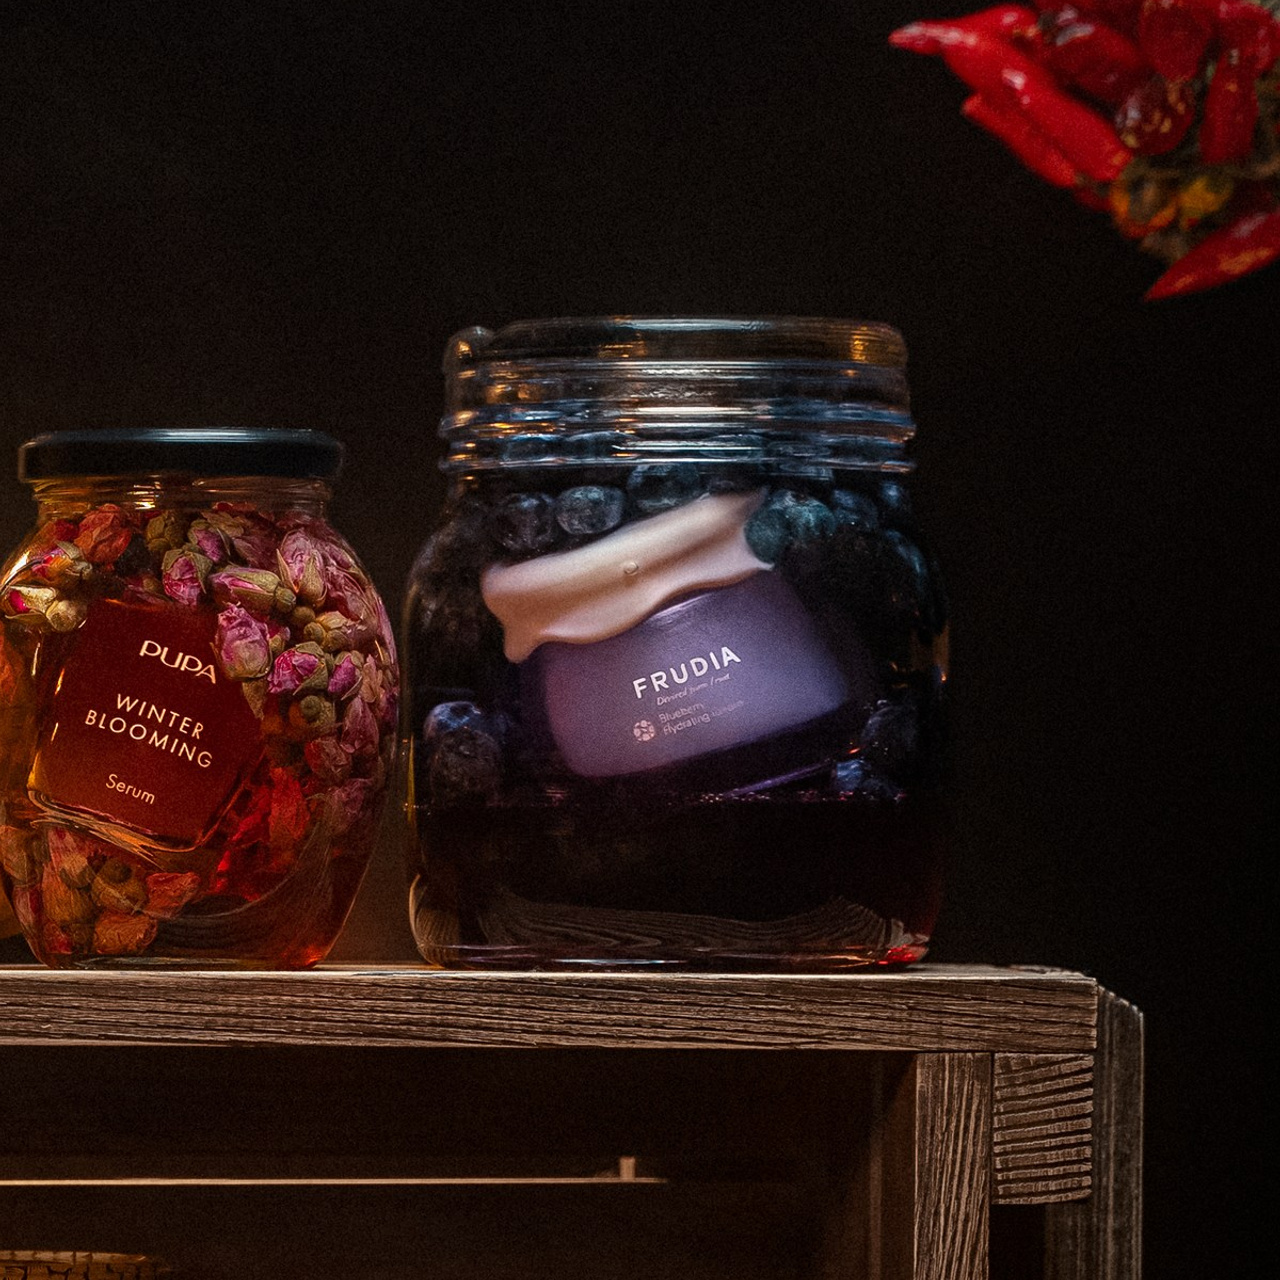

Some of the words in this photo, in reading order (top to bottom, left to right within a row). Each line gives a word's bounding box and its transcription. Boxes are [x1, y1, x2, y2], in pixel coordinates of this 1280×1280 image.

[139, 640, 217, 685] PUPA
[633, 646, 742, 699] FRUDIA
[84, 709, 213, 768] BLOOMING
[116, 693, 204, 740] WINTER
[105, 773, 155, 805] Serum
